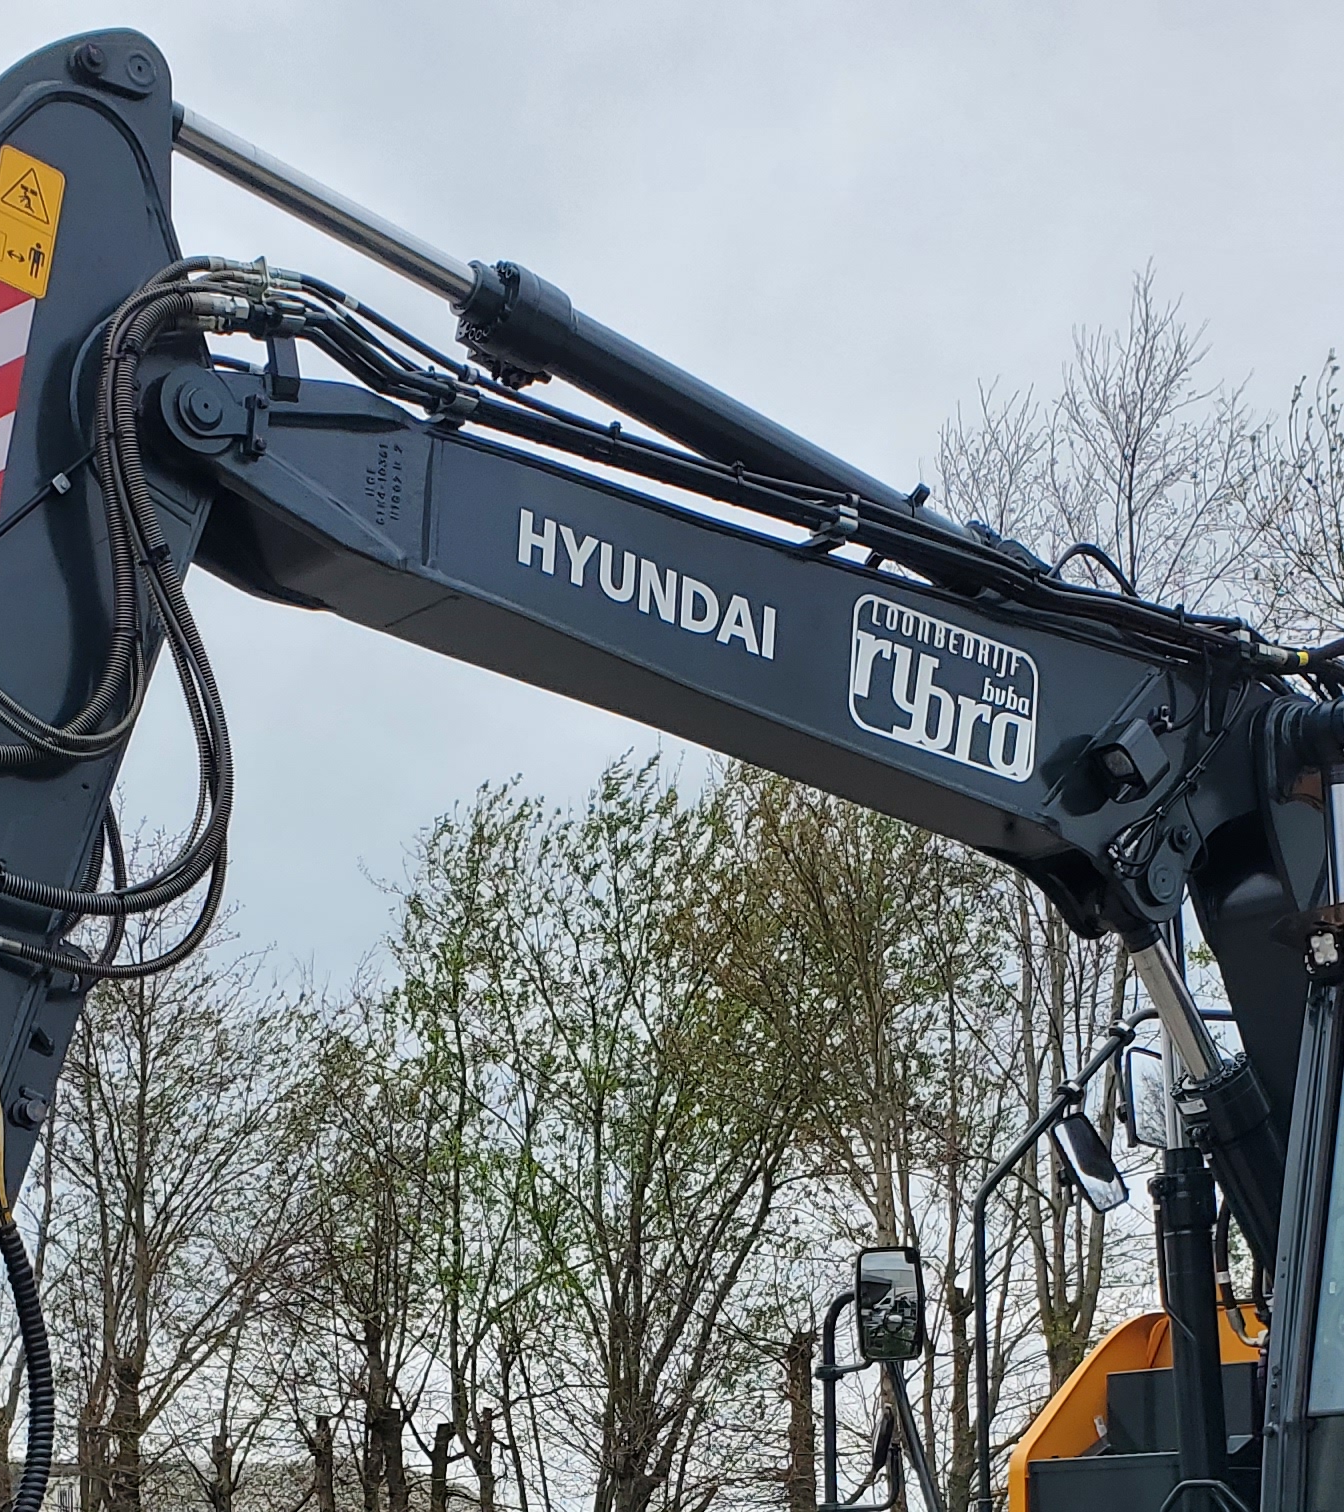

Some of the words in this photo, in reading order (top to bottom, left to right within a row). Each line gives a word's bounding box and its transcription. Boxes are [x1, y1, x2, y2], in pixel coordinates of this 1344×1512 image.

[517, 507, 777, 660] HYUNDAI
[871, 599, 1022, 678] LOONBEDRIJF
[981, 677, 1031, 716] bvba
